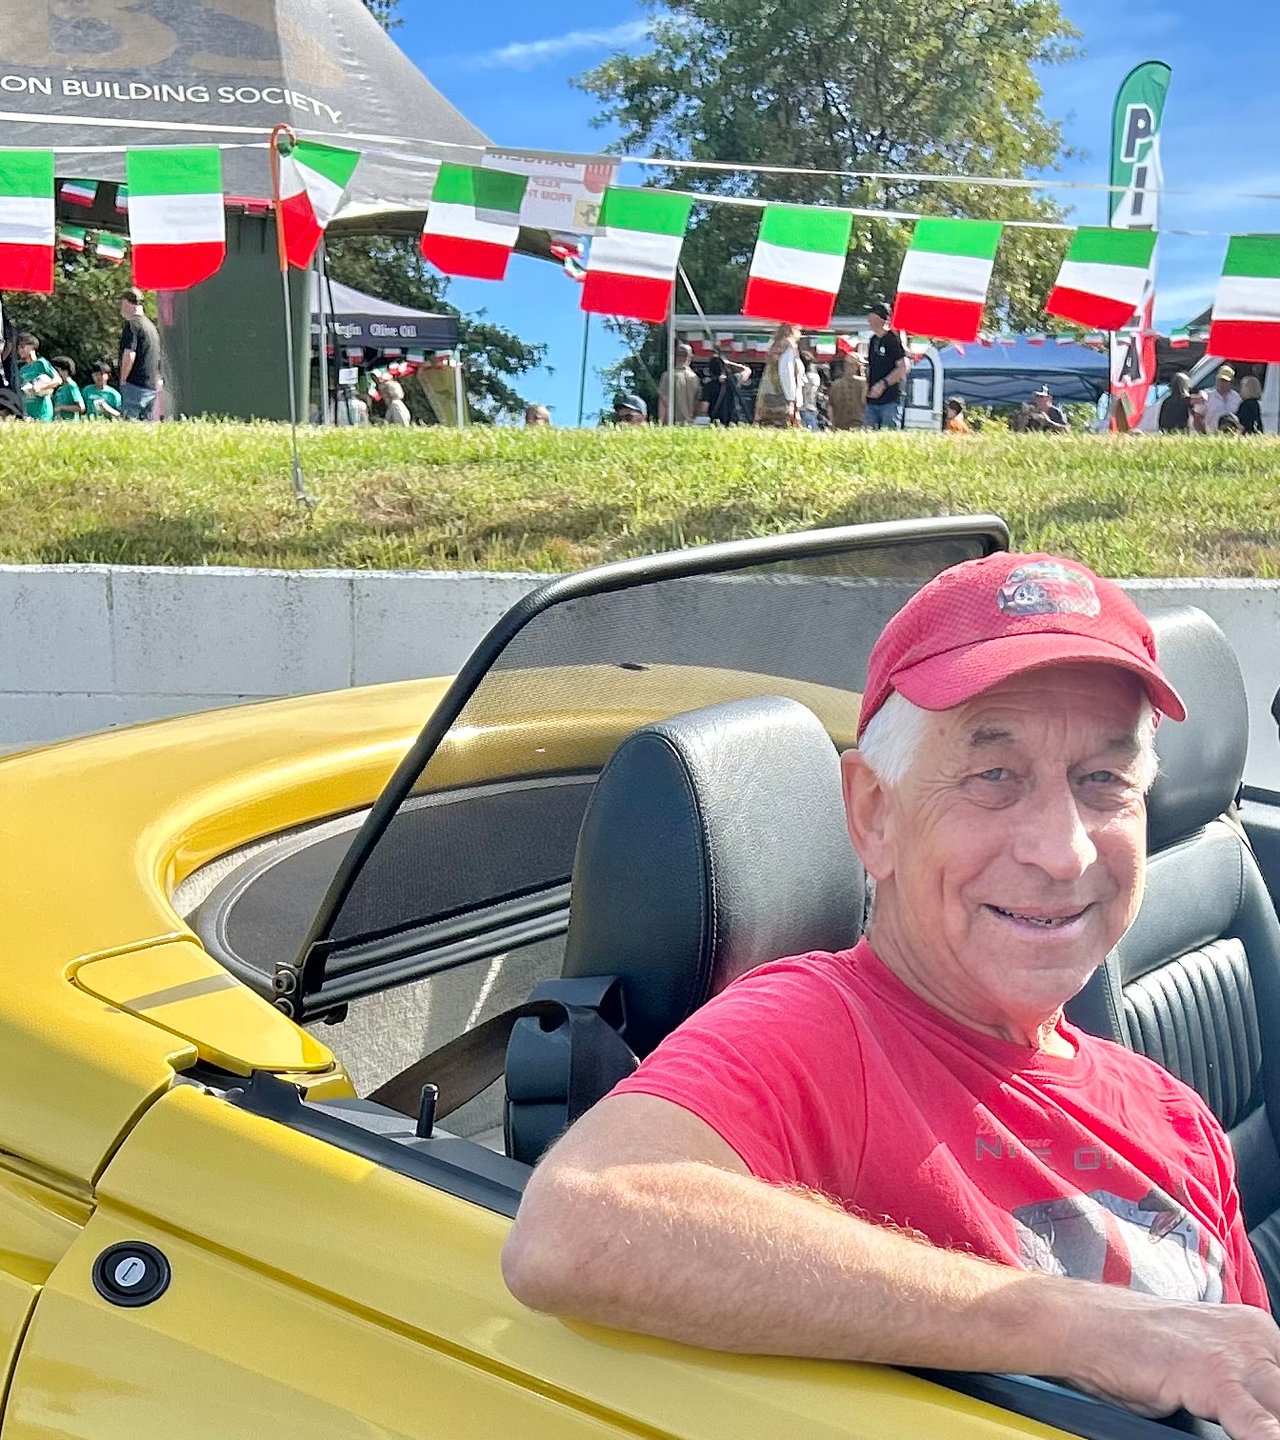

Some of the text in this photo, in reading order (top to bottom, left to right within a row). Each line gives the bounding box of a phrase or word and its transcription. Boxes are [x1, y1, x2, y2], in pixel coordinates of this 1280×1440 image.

[63, 78, 210, 105] BUILDING
[218, 87, 343, 126] SOCIETY
[1117, 104, 1155, 387] PIA
[369, 323, 399, 337] Olive
[400, 325, 418, 337] Oil
